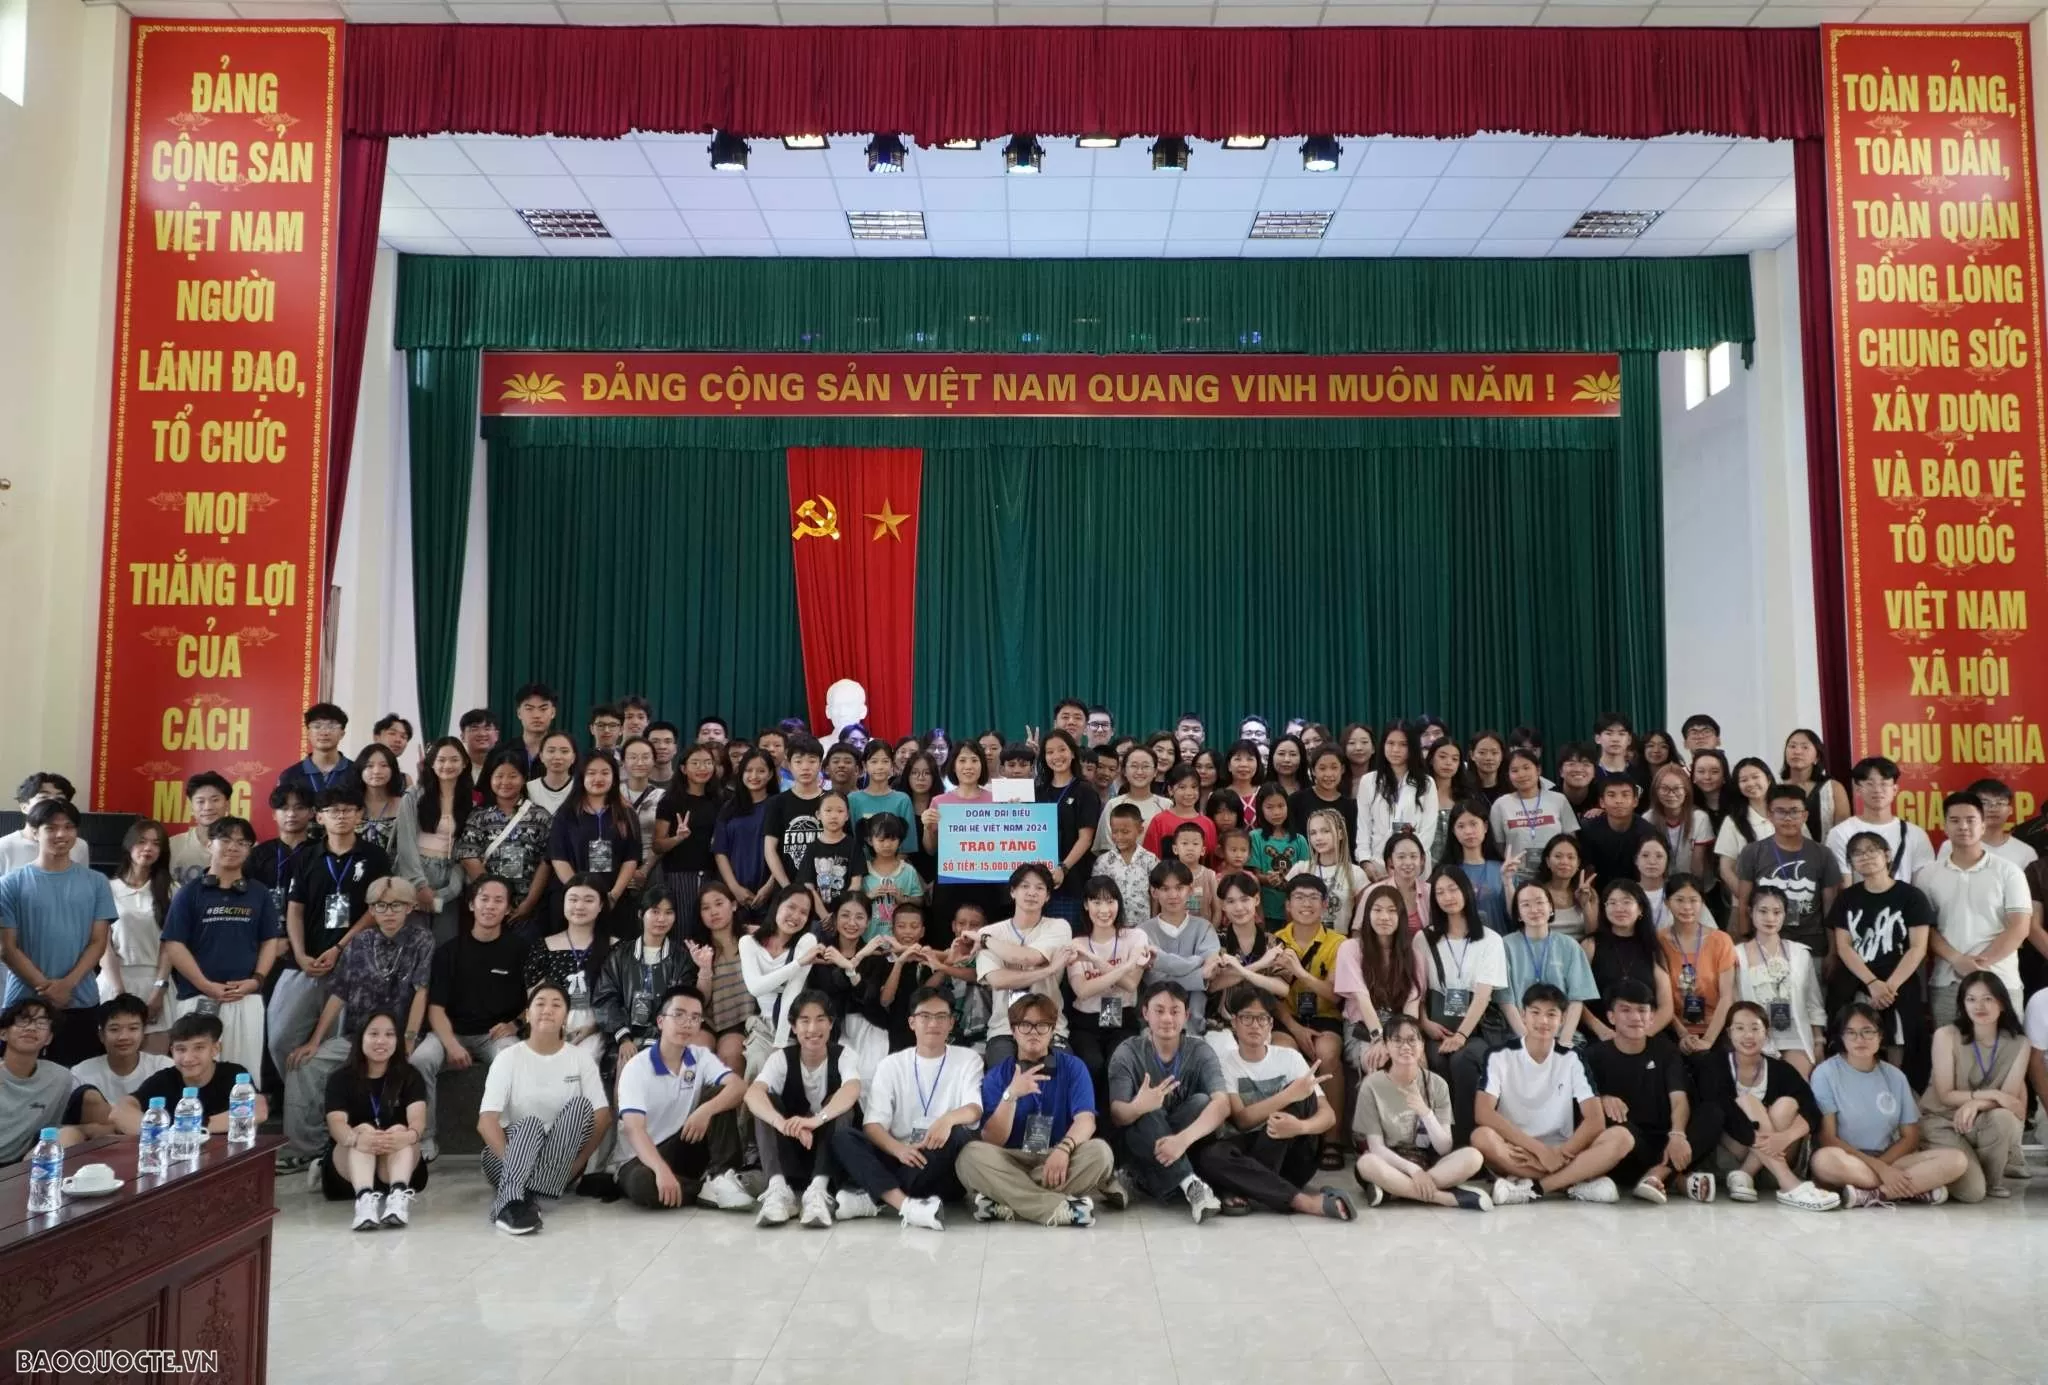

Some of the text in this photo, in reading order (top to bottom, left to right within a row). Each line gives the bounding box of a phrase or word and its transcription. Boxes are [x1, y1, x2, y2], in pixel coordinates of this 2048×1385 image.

[191, 55, 279, 114] ĐẢNG
[1843, 60, 2016, 118] TOÀN ĐẢNG,
[152, 125, 314, 191] CỘNG SẢN
[1855, 129, 2010, 181] TOÀN DÂN,
[154, 201, 304, 261] VIỆT NAM
[1853, 192, 2020, 242] TOÀN QUÂN
[176, 269, 275, 322] NGƯỜI
[1856, 251, 2024, 304] ĐỒNG LÒNG
[138, 341, 305, 402] LÃNH ĐẠO,
[1858, 318, 2028, 369] CHUNG SỨC
[582, 361, 686, 401] ĐẢNG
[701, 366, 804, 410] CỘNG
[818, 361, 890, 401] SẢN
[904, 366, 981, 409] VIỆT
[993, 375, 1076, 401] NAM
[1088, 374, 1219, 402] QUANG
[1233, 375, 1316, 401] VINH
[1330, 366, 1438, 401] MUÔN
[1451, 365, 1533, 401] NĂM
[1872, 385, 2020, 440] XÂY DỰNG
[152, 403, 287, 464] TỔ CHỨC
[1872, 443, 2026, 507] VÀ BẢO VỆ
[184, 491, 250, 544] MỌI
[1889, 509, 2016, 568] TỔ QUỐC
[129, 548, 297, 617] THẮNG LỢI
[1884, 582, 2028, 638] VIỆT NAM
[176, 617, 242, 678] CỦA
[1909, 649, 2010, 705] XÃ HỘI
[162, 698, 250, 751] CÁCH
[1881, 706, 2045, 764] CHỦ NGHĨA
[1026, 824, 1048, 832] 2024
[1896, 782, 1953, 831] GIÀ
[959, 841, 995, 852] TRAO
